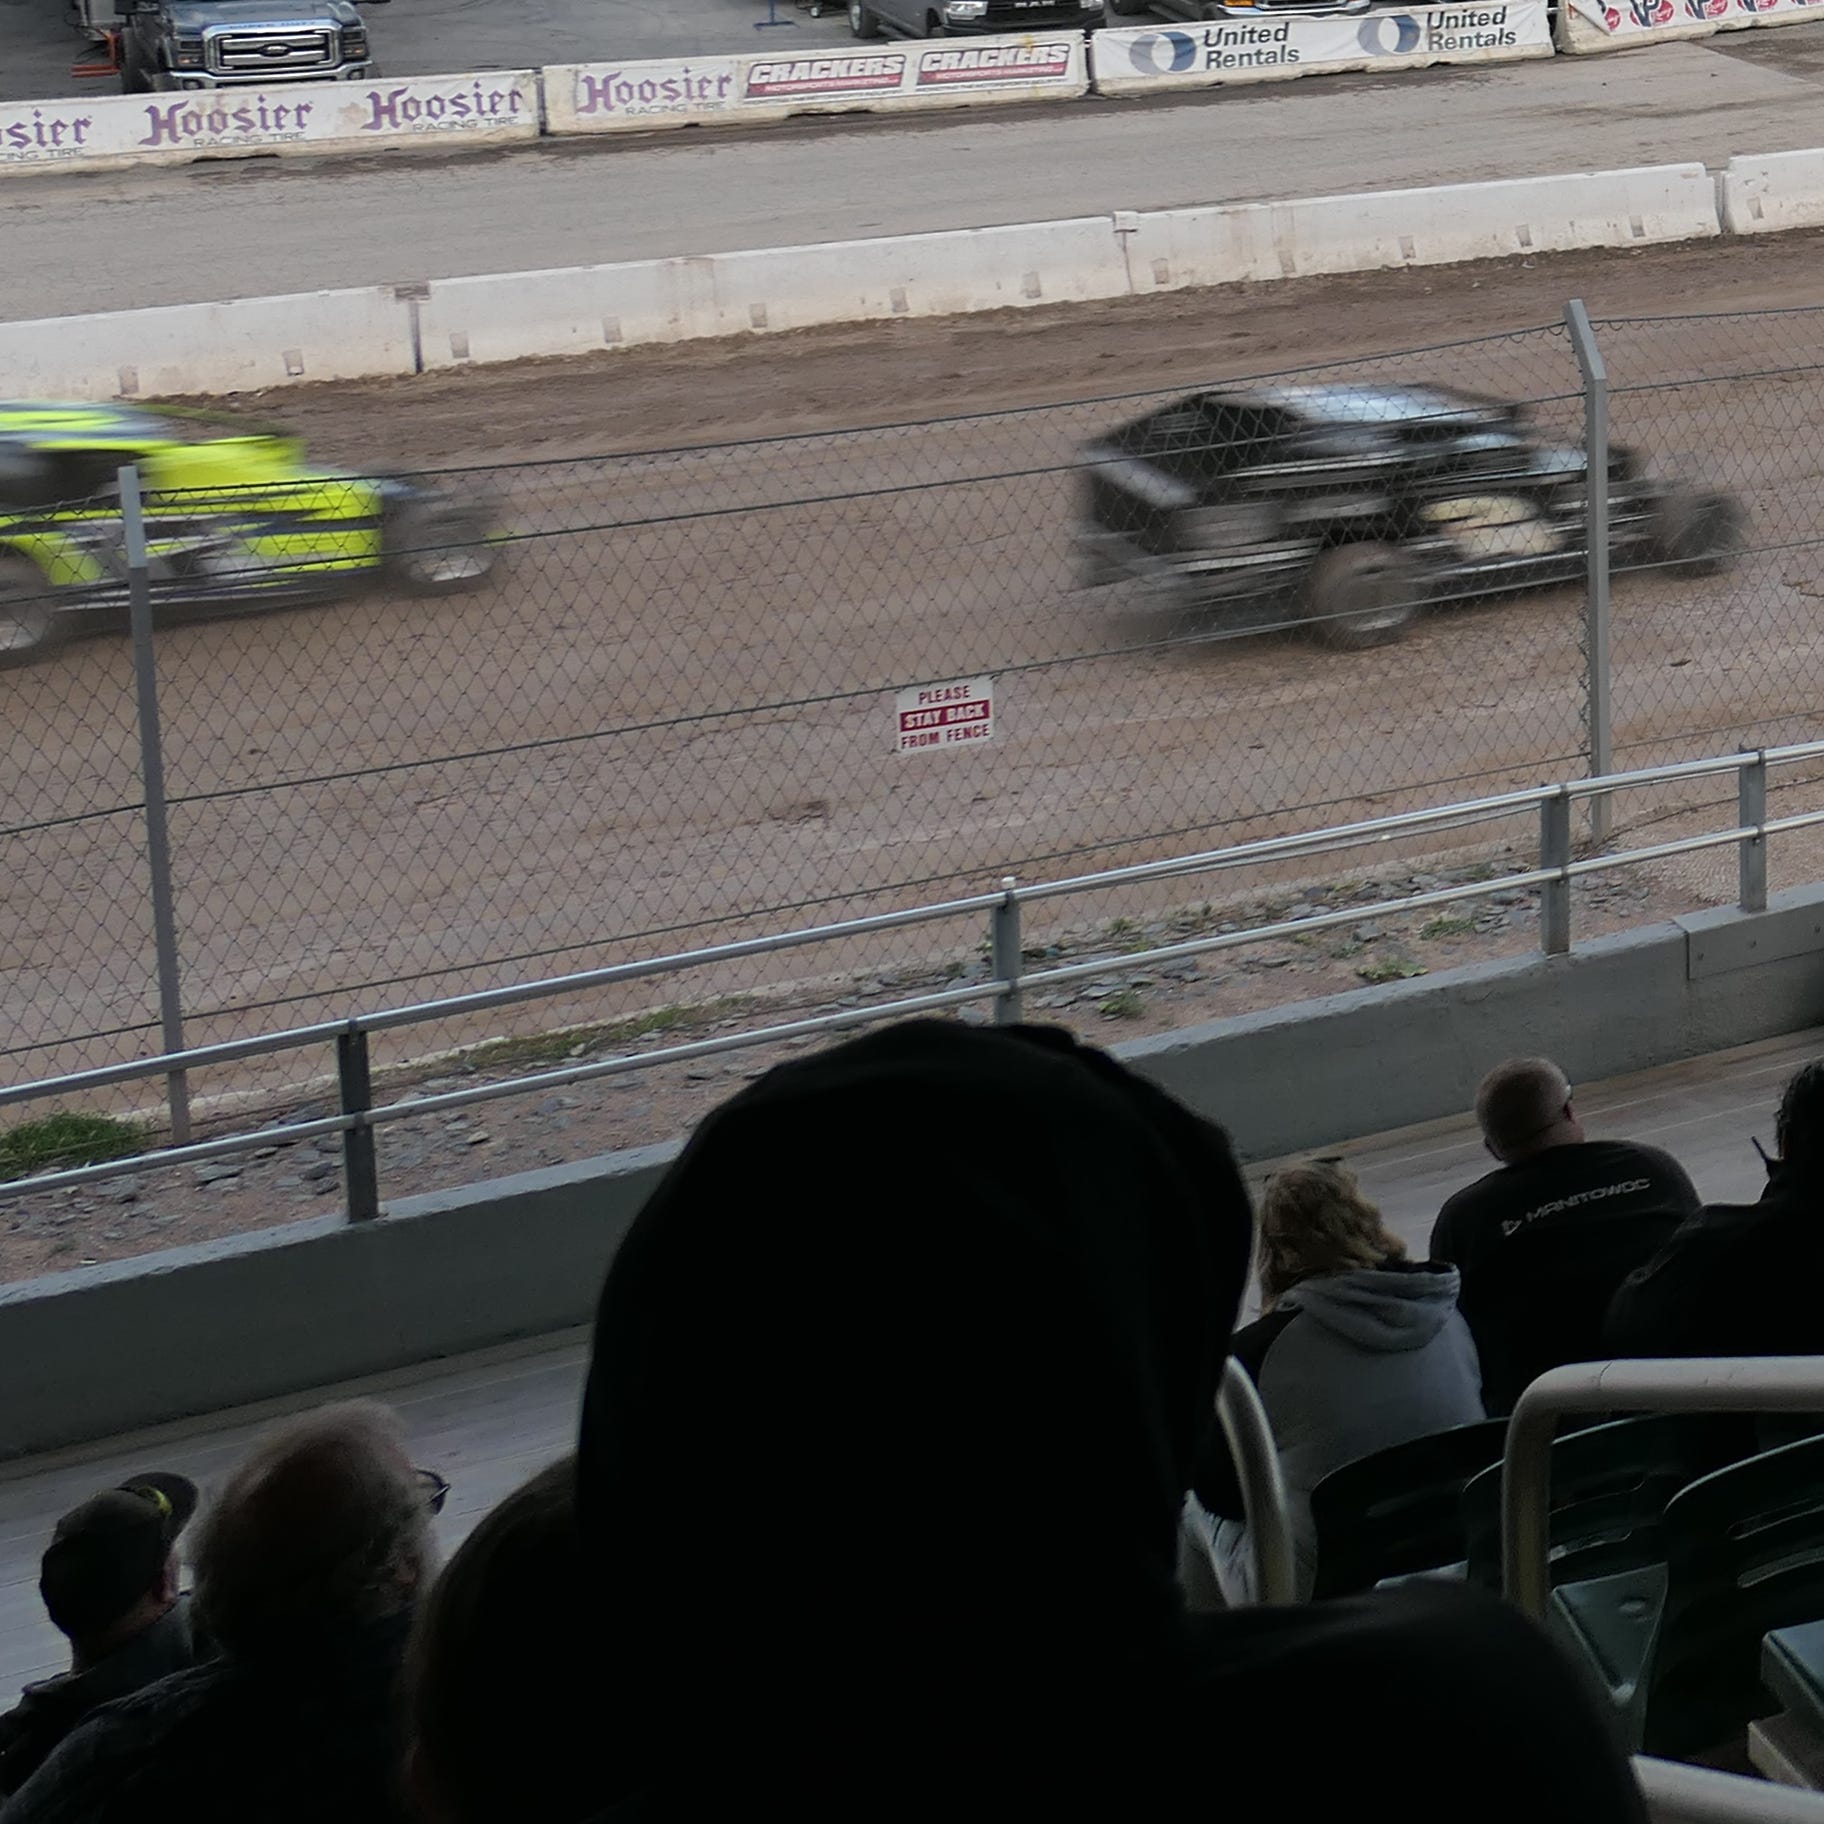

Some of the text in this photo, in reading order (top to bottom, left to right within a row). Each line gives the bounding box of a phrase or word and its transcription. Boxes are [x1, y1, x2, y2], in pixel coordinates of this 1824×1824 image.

[1427, 6, 1506, 29] United
[1204, 22, 1289, 47] United
[1429, 28, 1516, 50] Rentals
[921, 45, 1069, 72] CRACKERS
[1206, 45, 1300, 69] Rentals
[750, 56, 905, 84] CRACKERS
[576, 66, 733, 114] Hoosier
[361, 81, 523, 131] Hoosier
[625, 100, 725, 116] RACING TIRE
[138, 94, 313, 146] Hoosier
[413, 115, 520, 131] RACING TIRE
[193, 131, 306, 147] RACING TIRE
[47, 146, 84, 158] TIRE
[919, 685, 970, 704] PLEASE
[905, 703, 984, 728] STAY BACK
[901, 724, 990, 749] FROM FENCE
[1526, 1178, 1650, 1222] MANITOWOC
